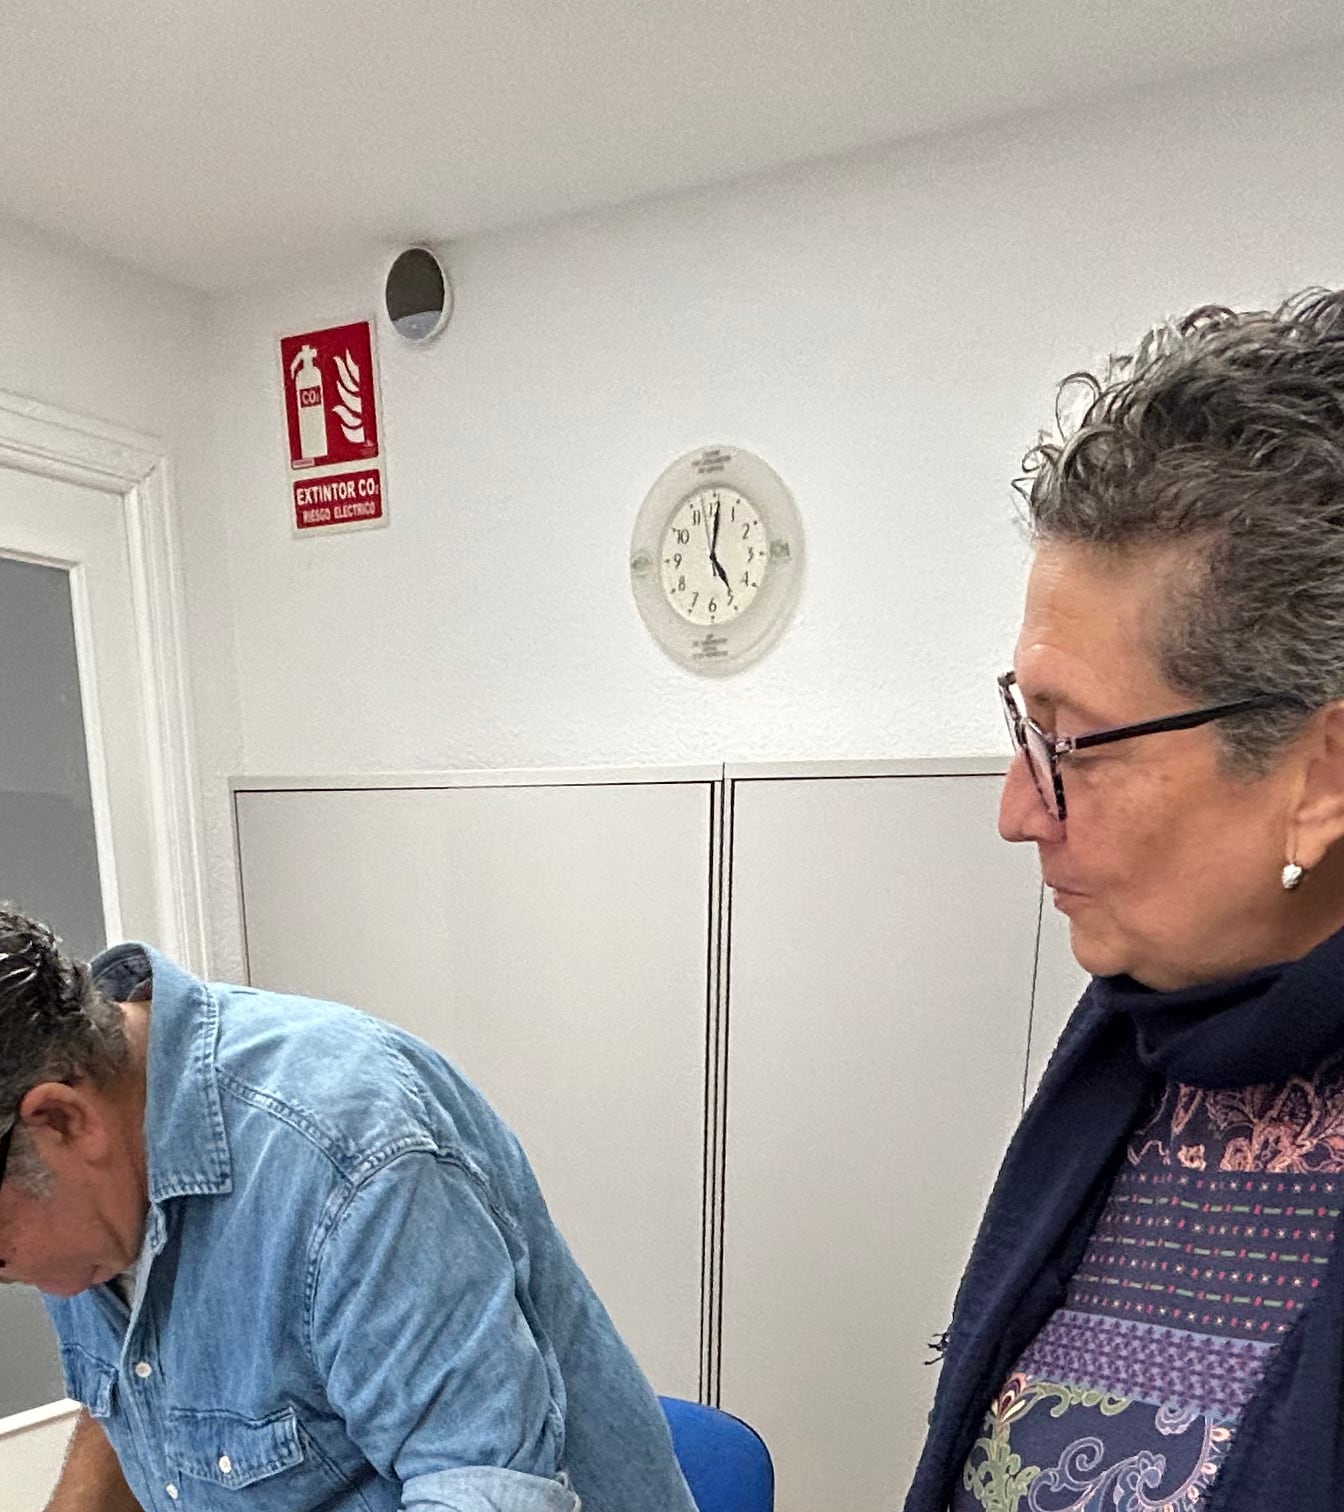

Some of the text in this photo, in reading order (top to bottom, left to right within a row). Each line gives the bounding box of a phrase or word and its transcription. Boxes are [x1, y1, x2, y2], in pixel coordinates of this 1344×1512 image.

[297, 481, 356, 505] EXTINTOR
[303, 508, 331, 524] RIESGO
[693, 510, 701, 526] 11
[677, 529, 690, 544] 10
[742, 523, 750, 539] 2
[674, 553, 682, 570] 9
[678, 575, 685, 592] 8
[741, 571, 748, 587] 4
[692, 592, 699, 608] 7
[709, 598, 717, 612] 6
